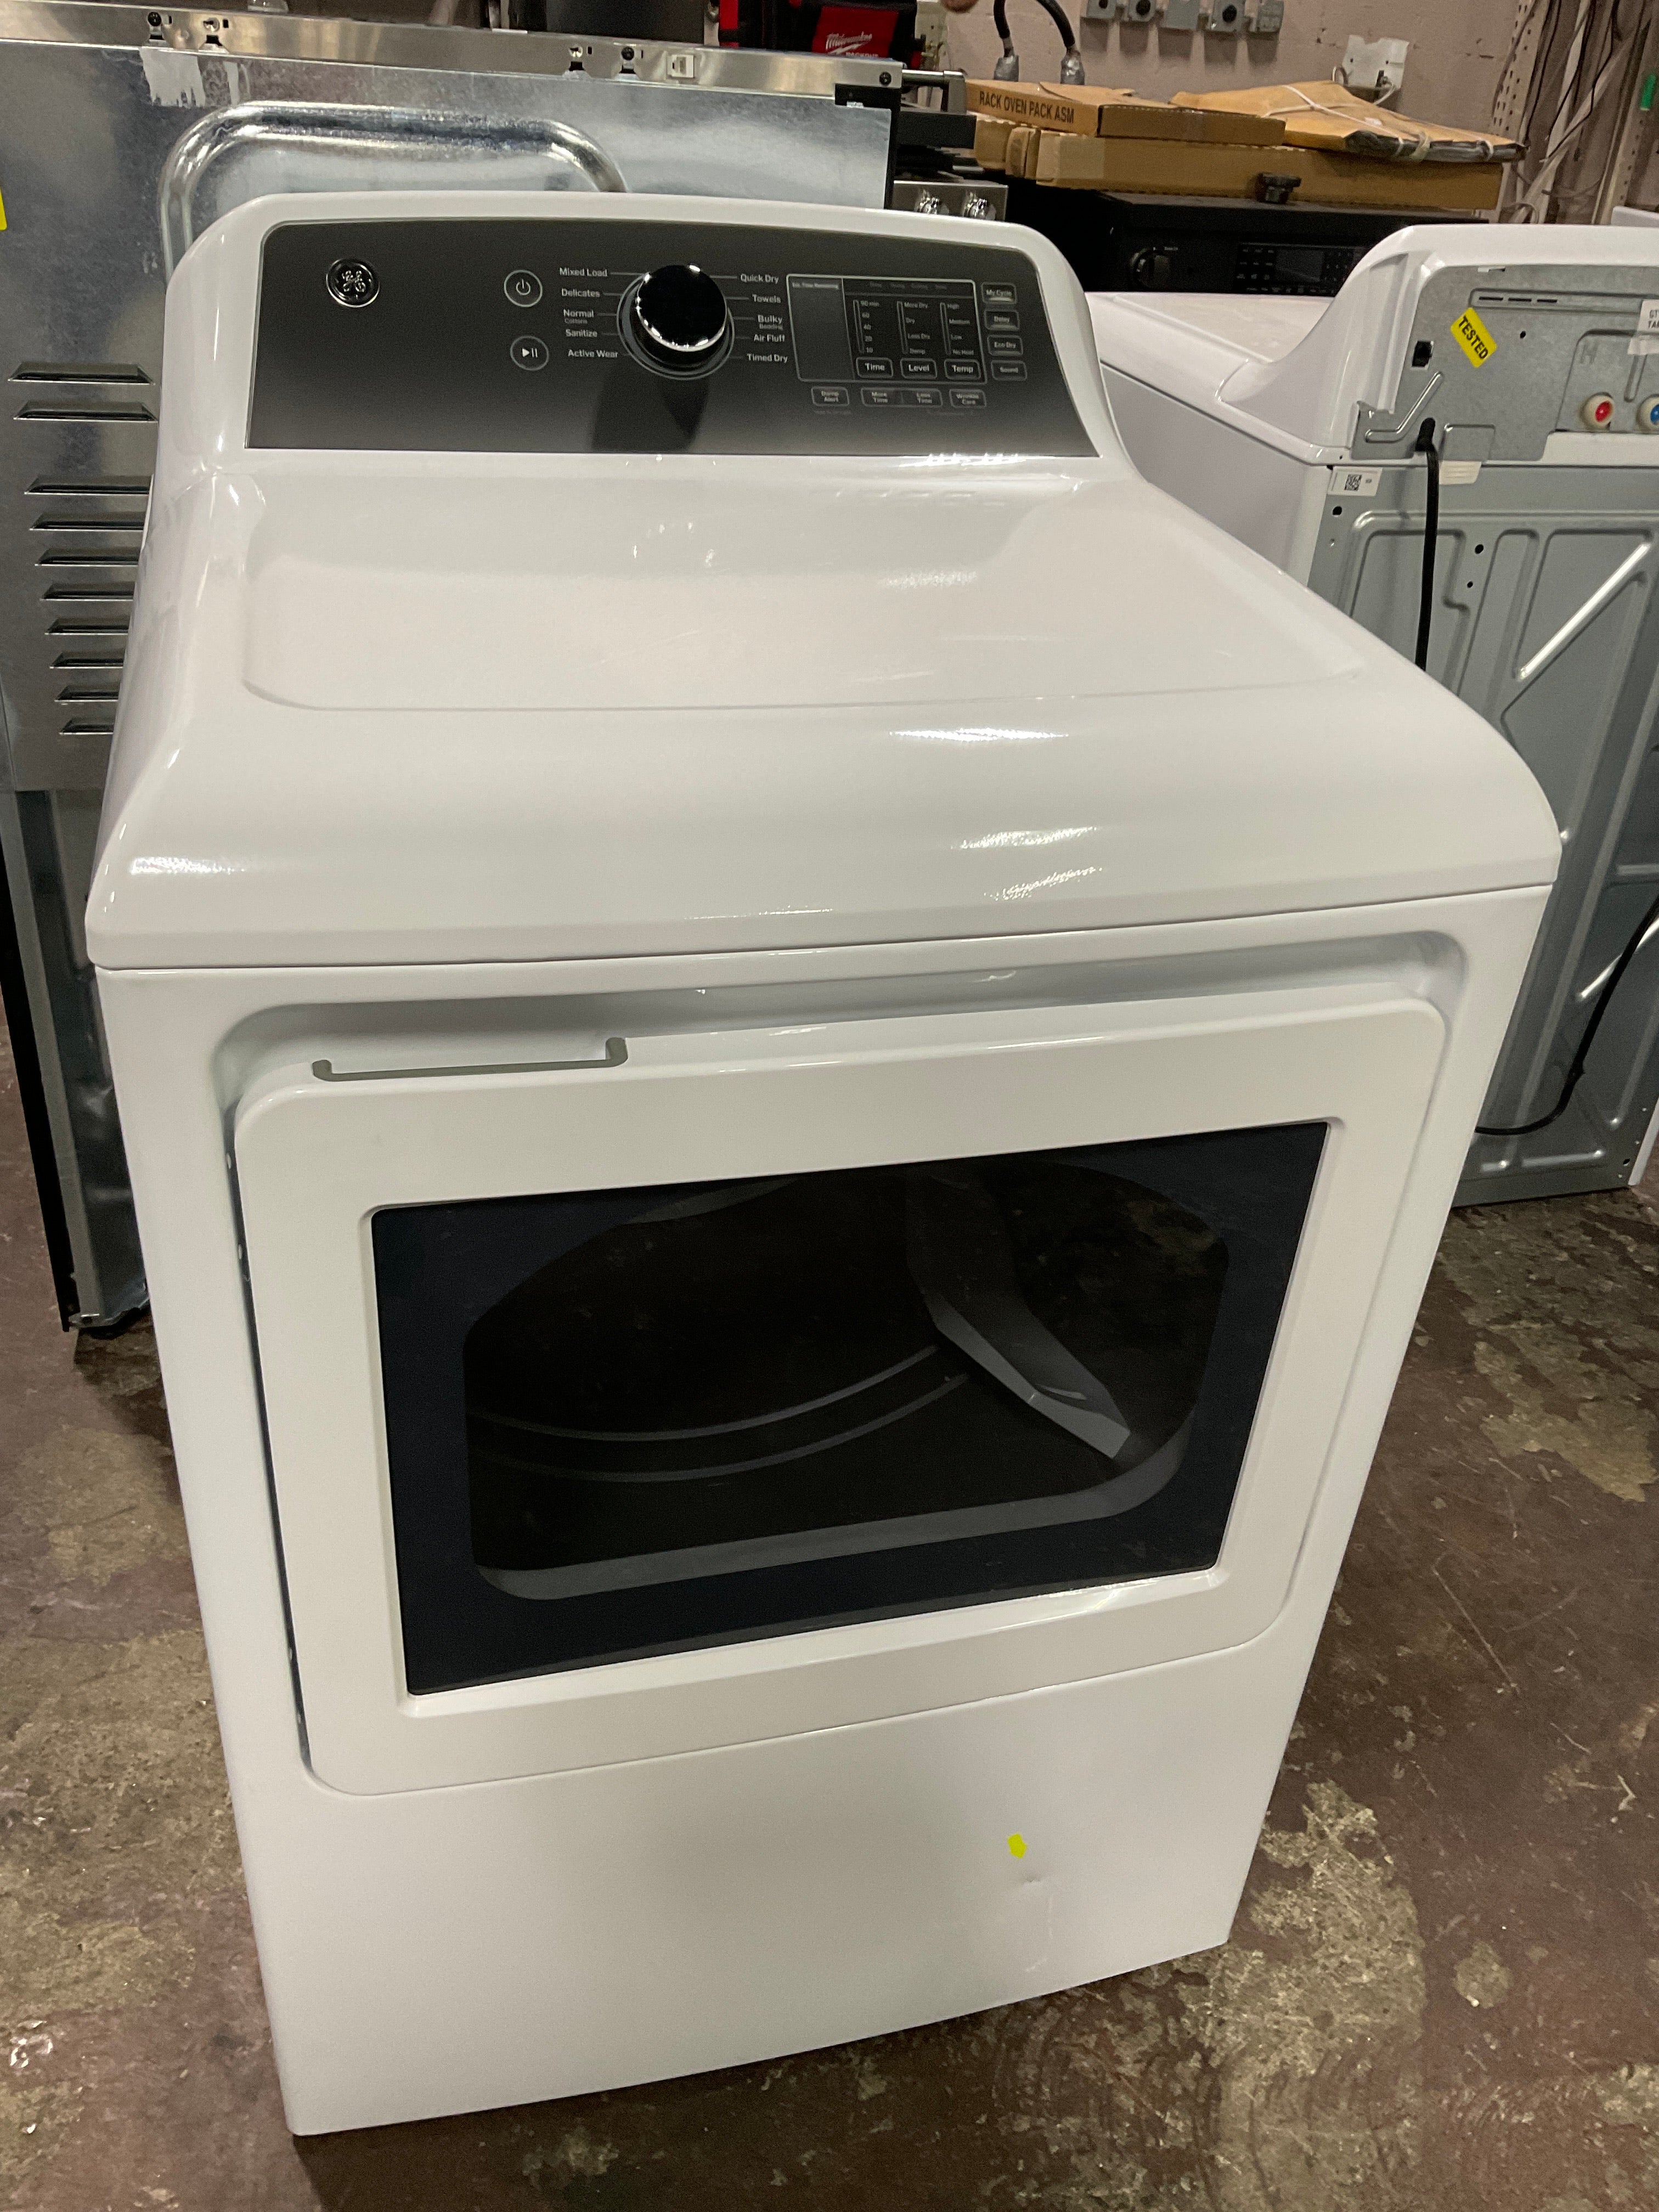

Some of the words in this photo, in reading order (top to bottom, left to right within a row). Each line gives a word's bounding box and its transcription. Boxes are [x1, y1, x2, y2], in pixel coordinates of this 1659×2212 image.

[979, 91, 1002, 110] RACK
[1003, 96, 1027, 115] OVEN
[1029, 100, 1053, 120] PACK
[1054, 105, 1075, 124] ASM
[559, 267, 585, 276] Mixed
[586, 268, 608, 277] Load
[740, 273, 764, 283] Quick
[765, 274, 779, 284] Dry
[561, 288, 600, 297] Delicates
[752, 294, 781, 303] Towels
[563, 308, 594, 318] Normal
[758, 314, 783, 324] Bulky
[565, 328, 598, 337] Sanitize
[1459, 315, 1489, 359] TESTED
[754, 334, 765, 342] Air
[766, 334, 785, 342] Fluff
[568, 349, 595, 357] Active
[596, 349, 618, 358] Wear
[746, 353, 772, 362] Timed
[774, 354, 788, 363] Dry
[864, 362, 885, 371] Time
[908, 363, 930, 373] Level
[951, 364, 974, 374] Temp
